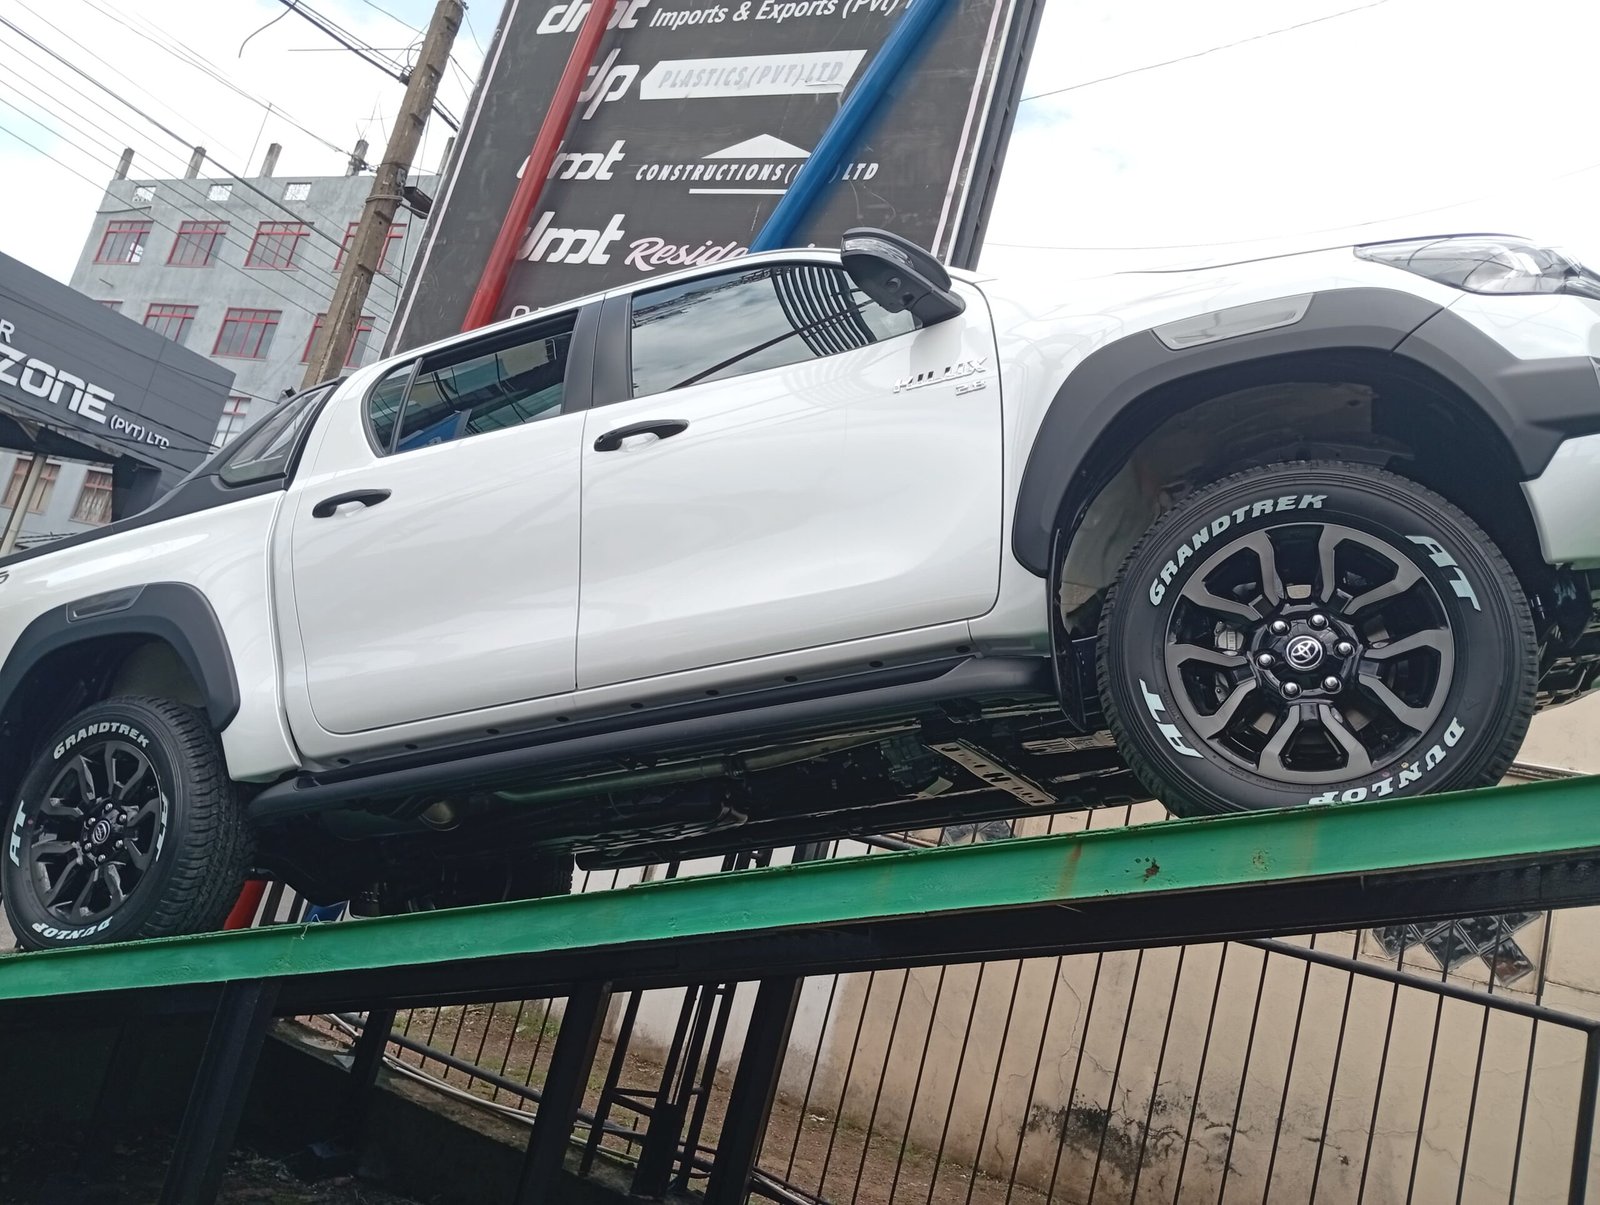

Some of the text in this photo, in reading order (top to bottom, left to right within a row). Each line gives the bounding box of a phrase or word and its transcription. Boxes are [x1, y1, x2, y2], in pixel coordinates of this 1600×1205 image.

[649, 8, 729, 31] Imports
[732, 2, 751, 22] &
[755, 0, 836, 23] Exports
[841, 163, 880, 181] LTD
[109, 414, 170, 450] (PVT) LTD
[1149, 494, 1328, 606] GRANDTREK
[53, 722, 149, 760] GRANDTREK
[1308, 716, 1466, 806] DUNLOP
[31, 916, 114, 941] DUNLOP
